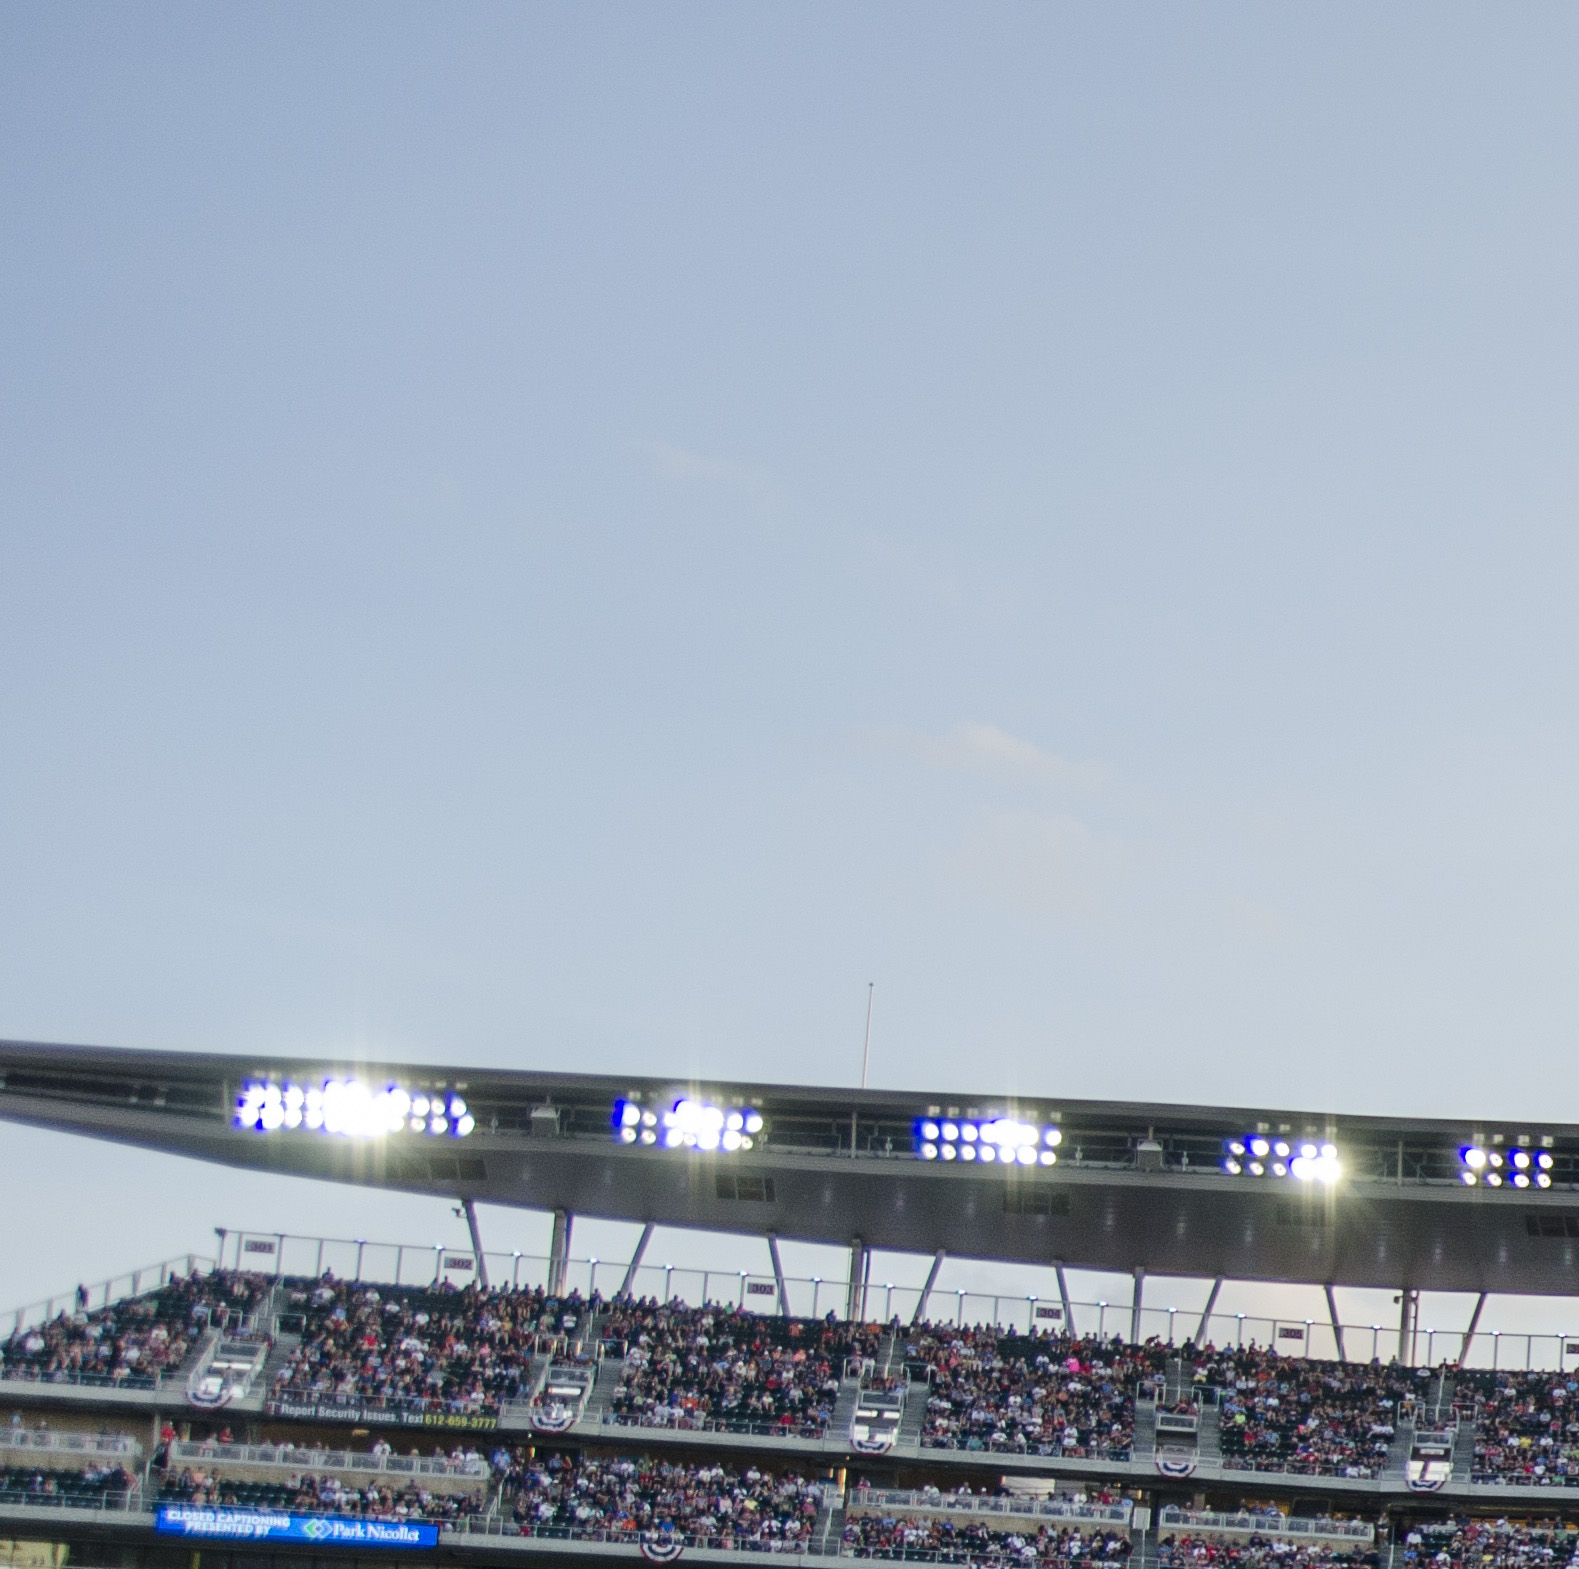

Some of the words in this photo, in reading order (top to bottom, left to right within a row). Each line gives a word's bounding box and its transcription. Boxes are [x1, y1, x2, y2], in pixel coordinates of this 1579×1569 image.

[281, 1404, 316, 1417] Report
[318, 1406, 361, 1421] Security
[402, 1411, 423, 1424] Text
[167, 1510, 214, 1522] CLOSED
[217, 1512, 291, 1527] CAPTIONING
[185, 1521, 250, 1535] PRESENTED
[253, 1525, 270, 1536] BY
[333, 1522, 364, 1538] Park
[367, 1524, 419, 1541] Nicollet
